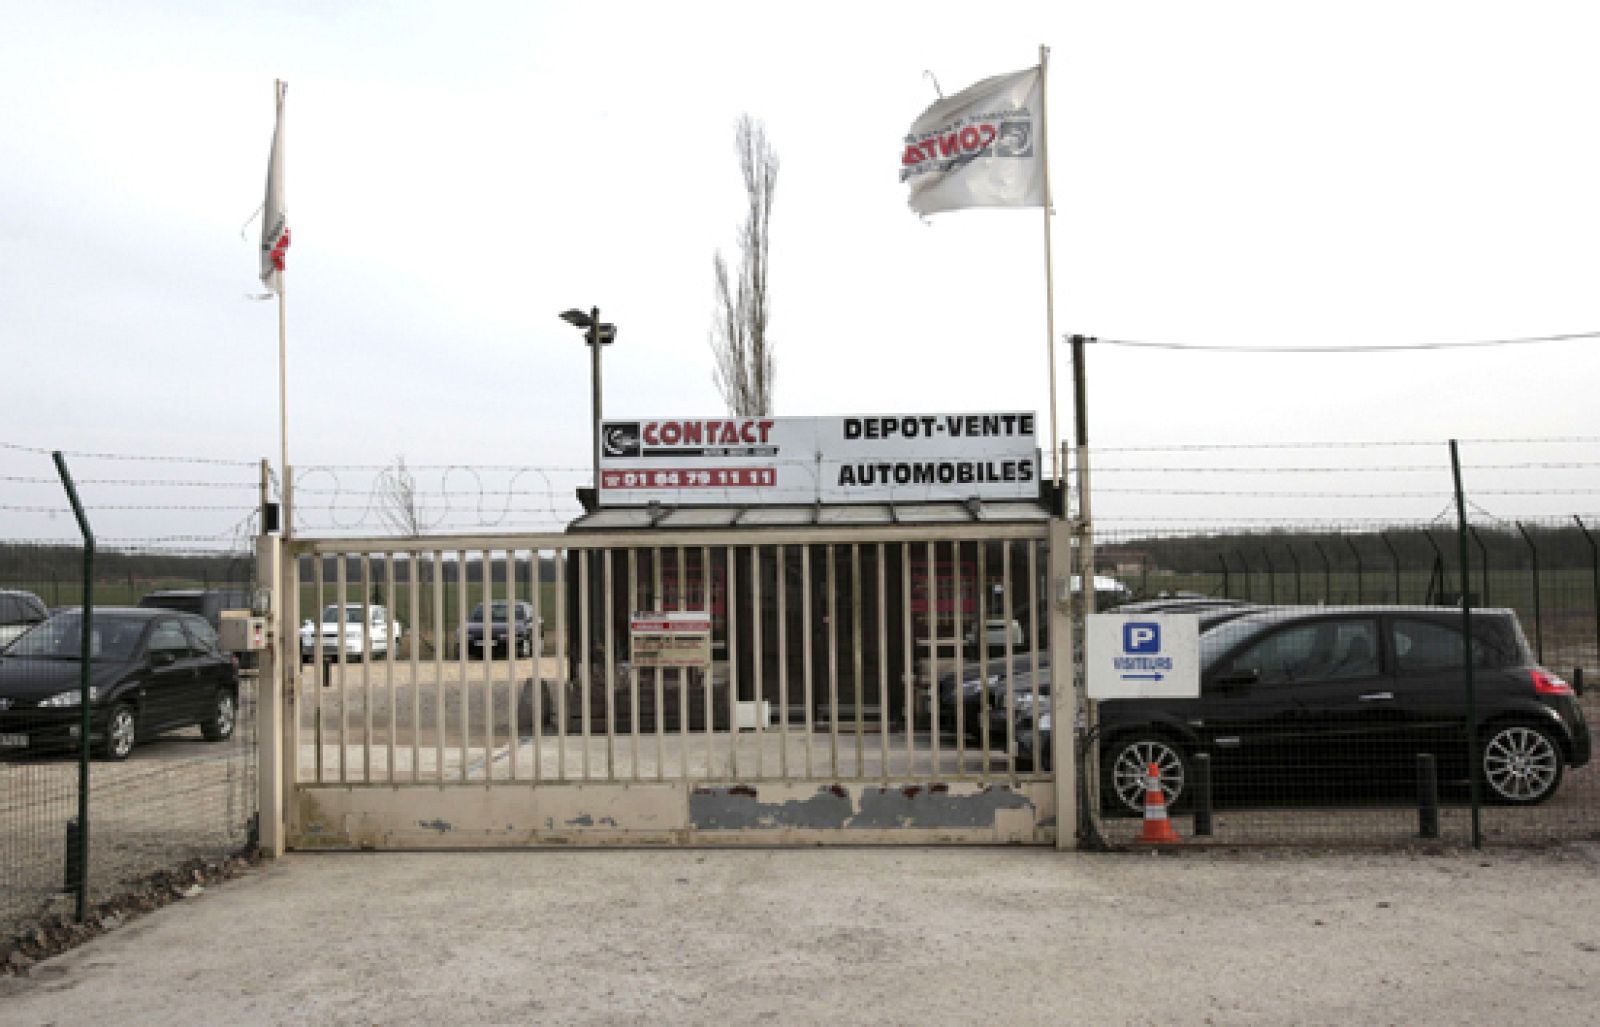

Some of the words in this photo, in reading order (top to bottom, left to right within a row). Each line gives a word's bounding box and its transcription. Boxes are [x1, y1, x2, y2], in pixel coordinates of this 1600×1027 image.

[643, 421, 774, 445] CONTACT
[844, 413, 1034, 439] DEPOT-VENTE
[624, 471, 647, 485] 01
[719, 470, 740, 484] 11
[750, 470, 772, 484] 11
[838, 460, 1033, 486] AUTOMOBILES
[1131, 627, 1154, 649] P
